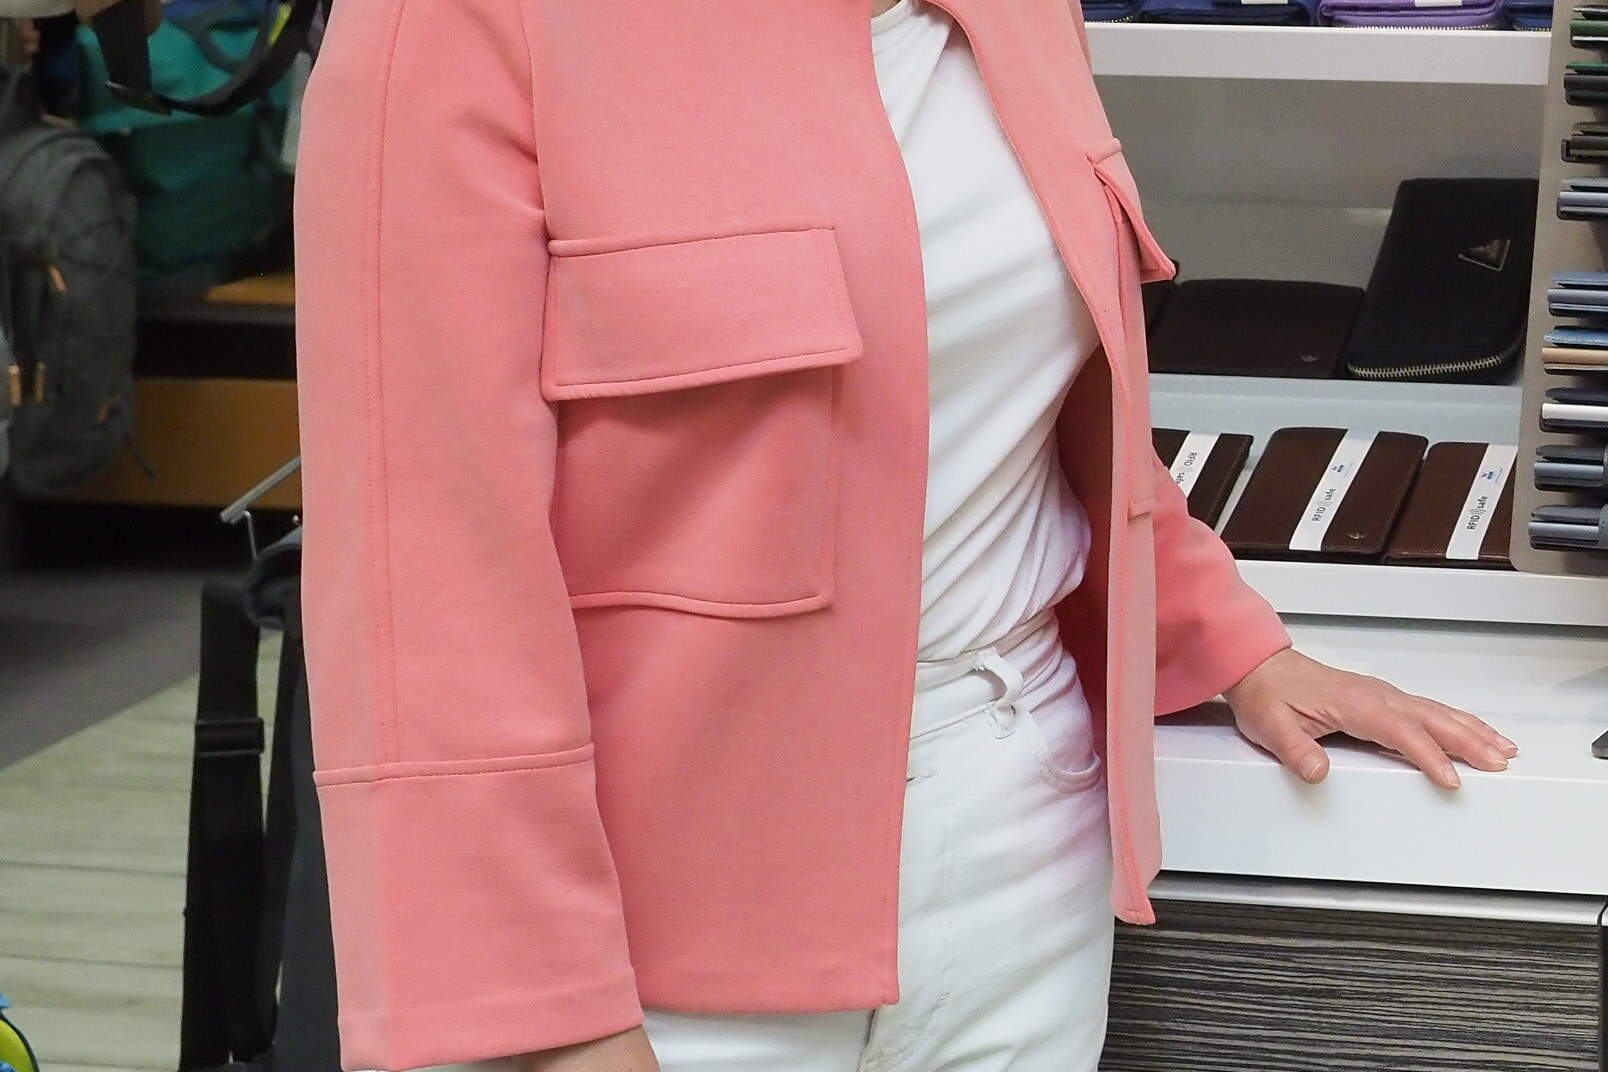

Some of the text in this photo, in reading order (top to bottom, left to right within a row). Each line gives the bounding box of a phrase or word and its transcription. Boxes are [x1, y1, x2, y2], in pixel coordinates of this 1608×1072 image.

[1312, 487, 1337, 522] RFID safe
[1466, 495, 1488, 530] RFID safe
